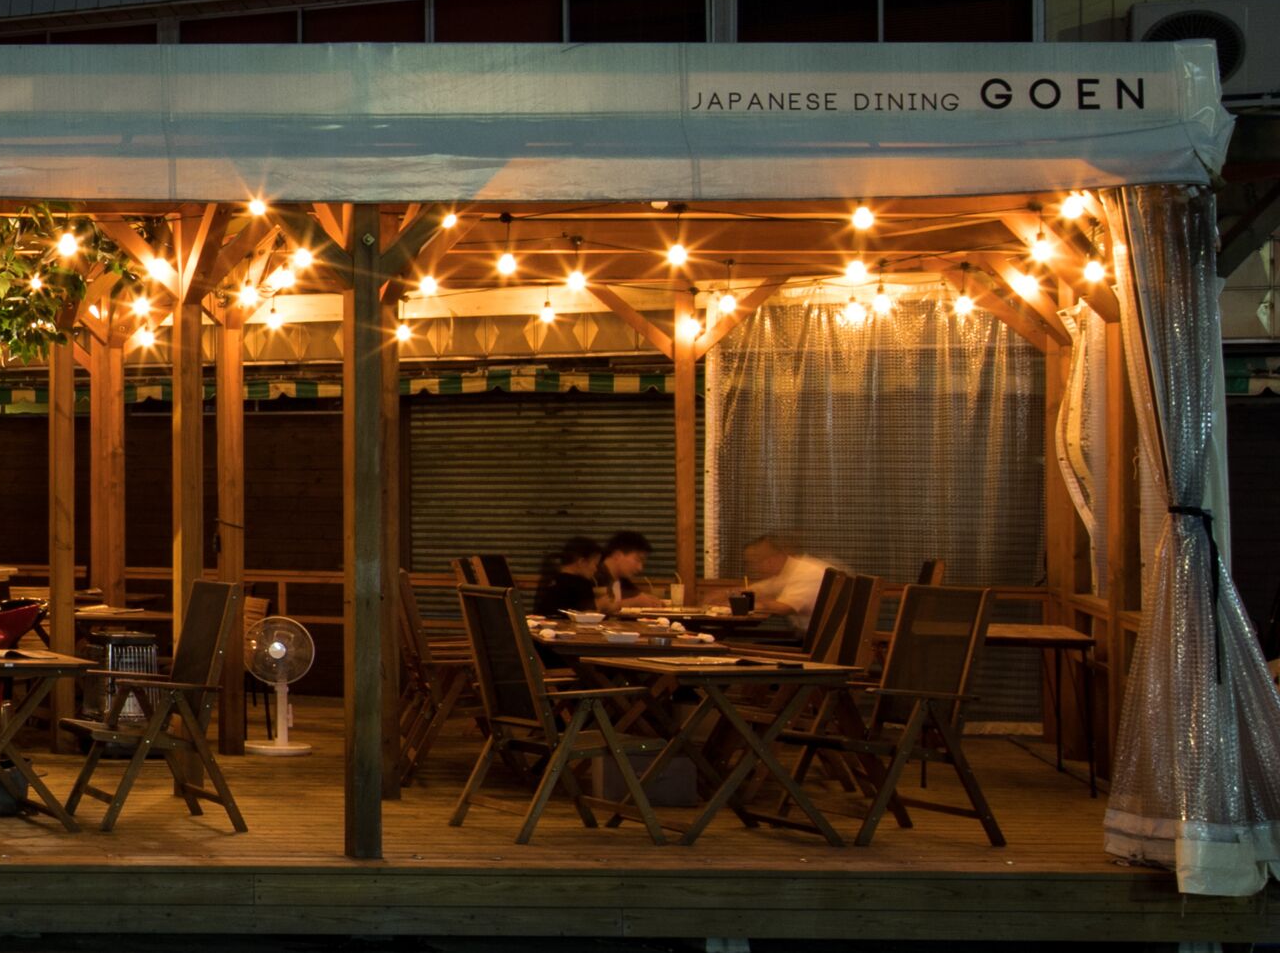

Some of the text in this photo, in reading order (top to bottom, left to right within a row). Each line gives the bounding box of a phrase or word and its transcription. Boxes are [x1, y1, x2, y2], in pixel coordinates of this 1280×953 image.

[691, 77, 1145, 111] JAPANESE DINING GOEN
